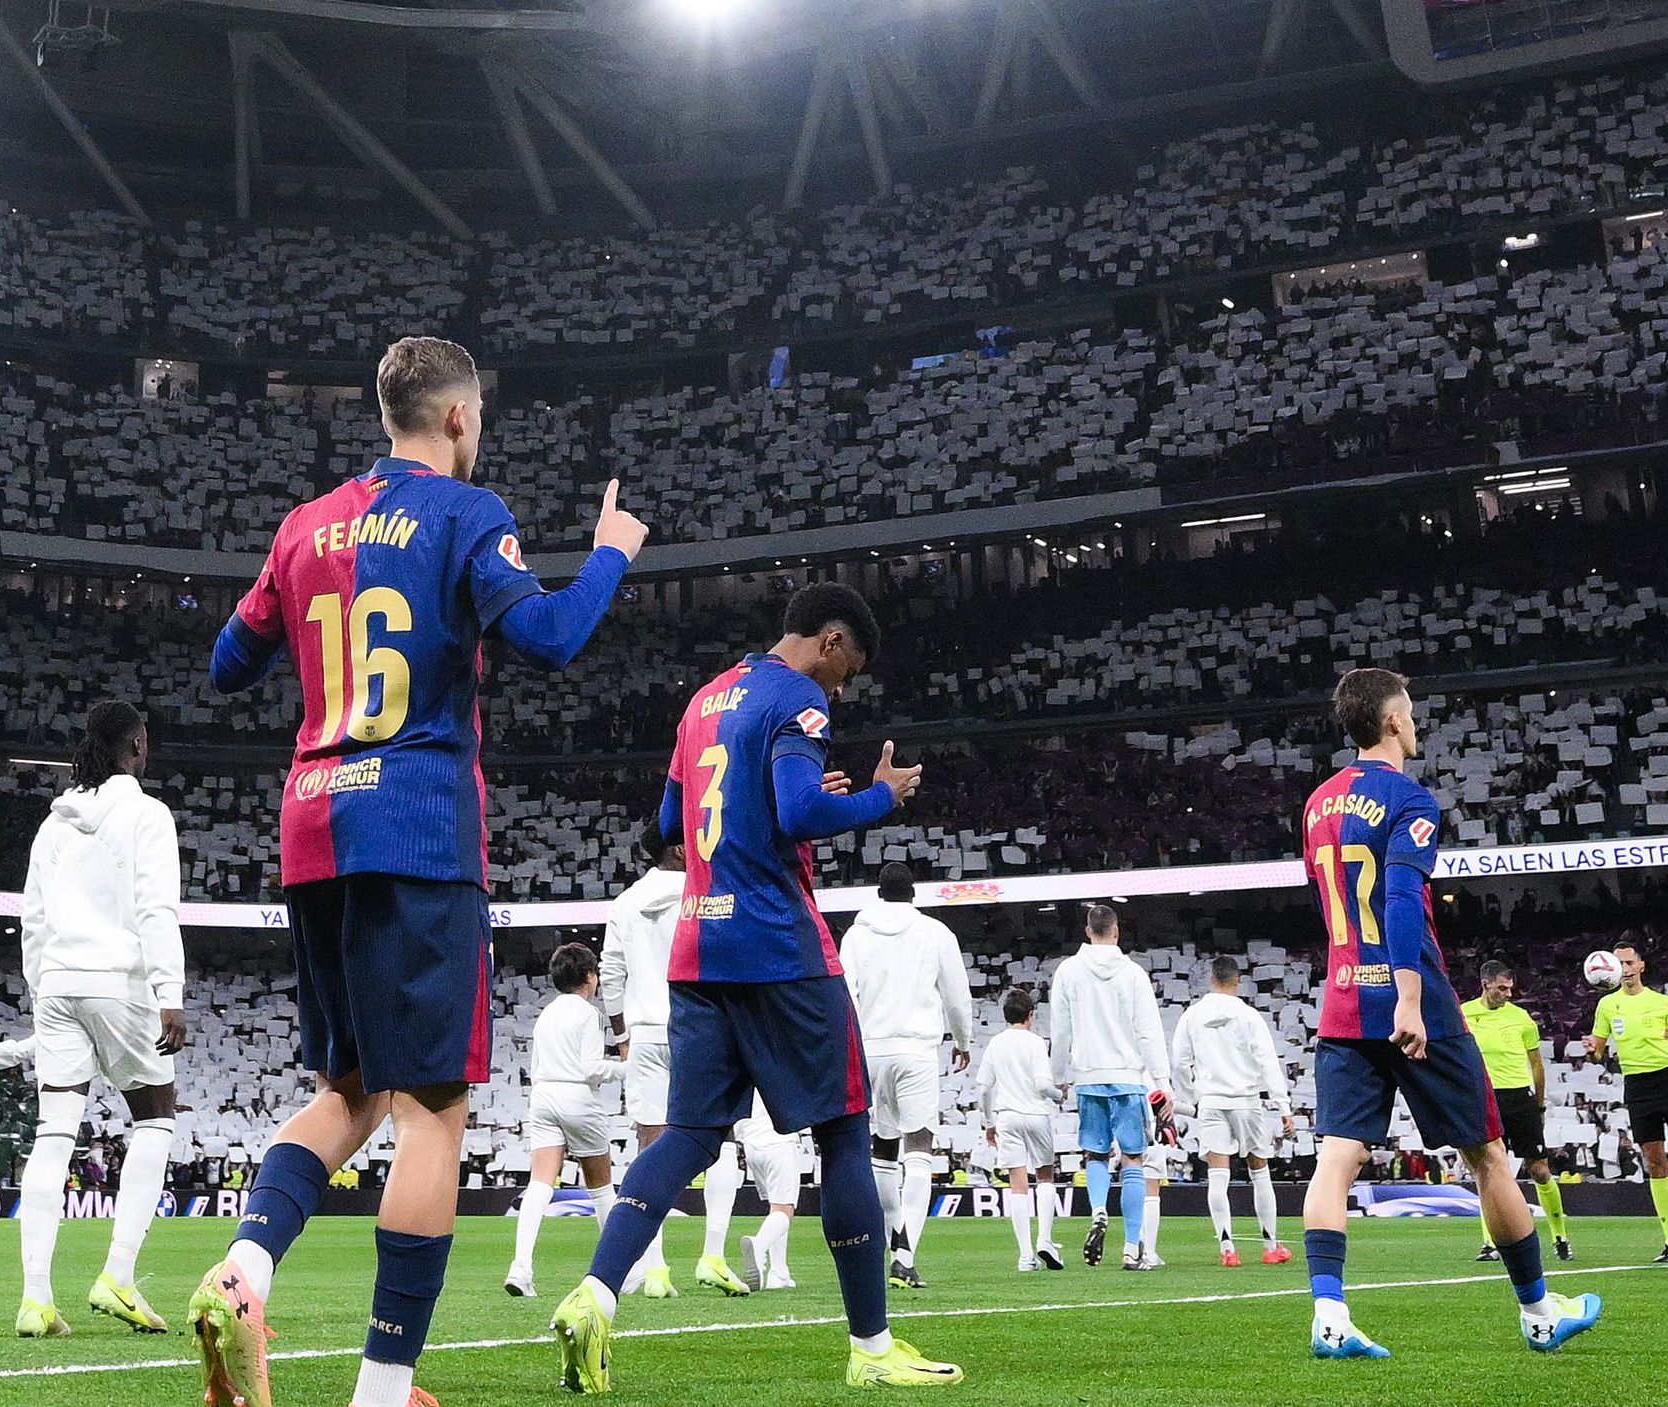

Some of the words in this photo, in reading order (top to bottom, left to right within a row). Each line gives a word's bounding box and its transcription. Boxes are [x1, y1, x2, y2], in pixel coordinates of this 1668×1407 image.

[313, 508, 419, 558] FERMÍN
[305, 586, 413, 746] 16
[700, 687, 749, 719] BALDE
[327, 771, 381, 790] ACNUR
[331, 757, 382, 777] UNHCR
[695, 744, 729, 863] 3
[1322, 793, 1387, 827] CASADÓ
[1442, 857, 1472, 876] YA
[1478, 850, 1554, 875] SALEN
[1561, 848, 1608, 869] LAS
[699, 893, 735, 905] UNHCR
[1314, 843, 1381, 947] 17
[260, 910, 284, 926] YA
[696, 904, 734, 916] ACNUR
[1352, 973, 1391, 983] ACNUR
[1353, 963, 1390, 974] UNHCR
[62, 1191, 120, 1219] MW
